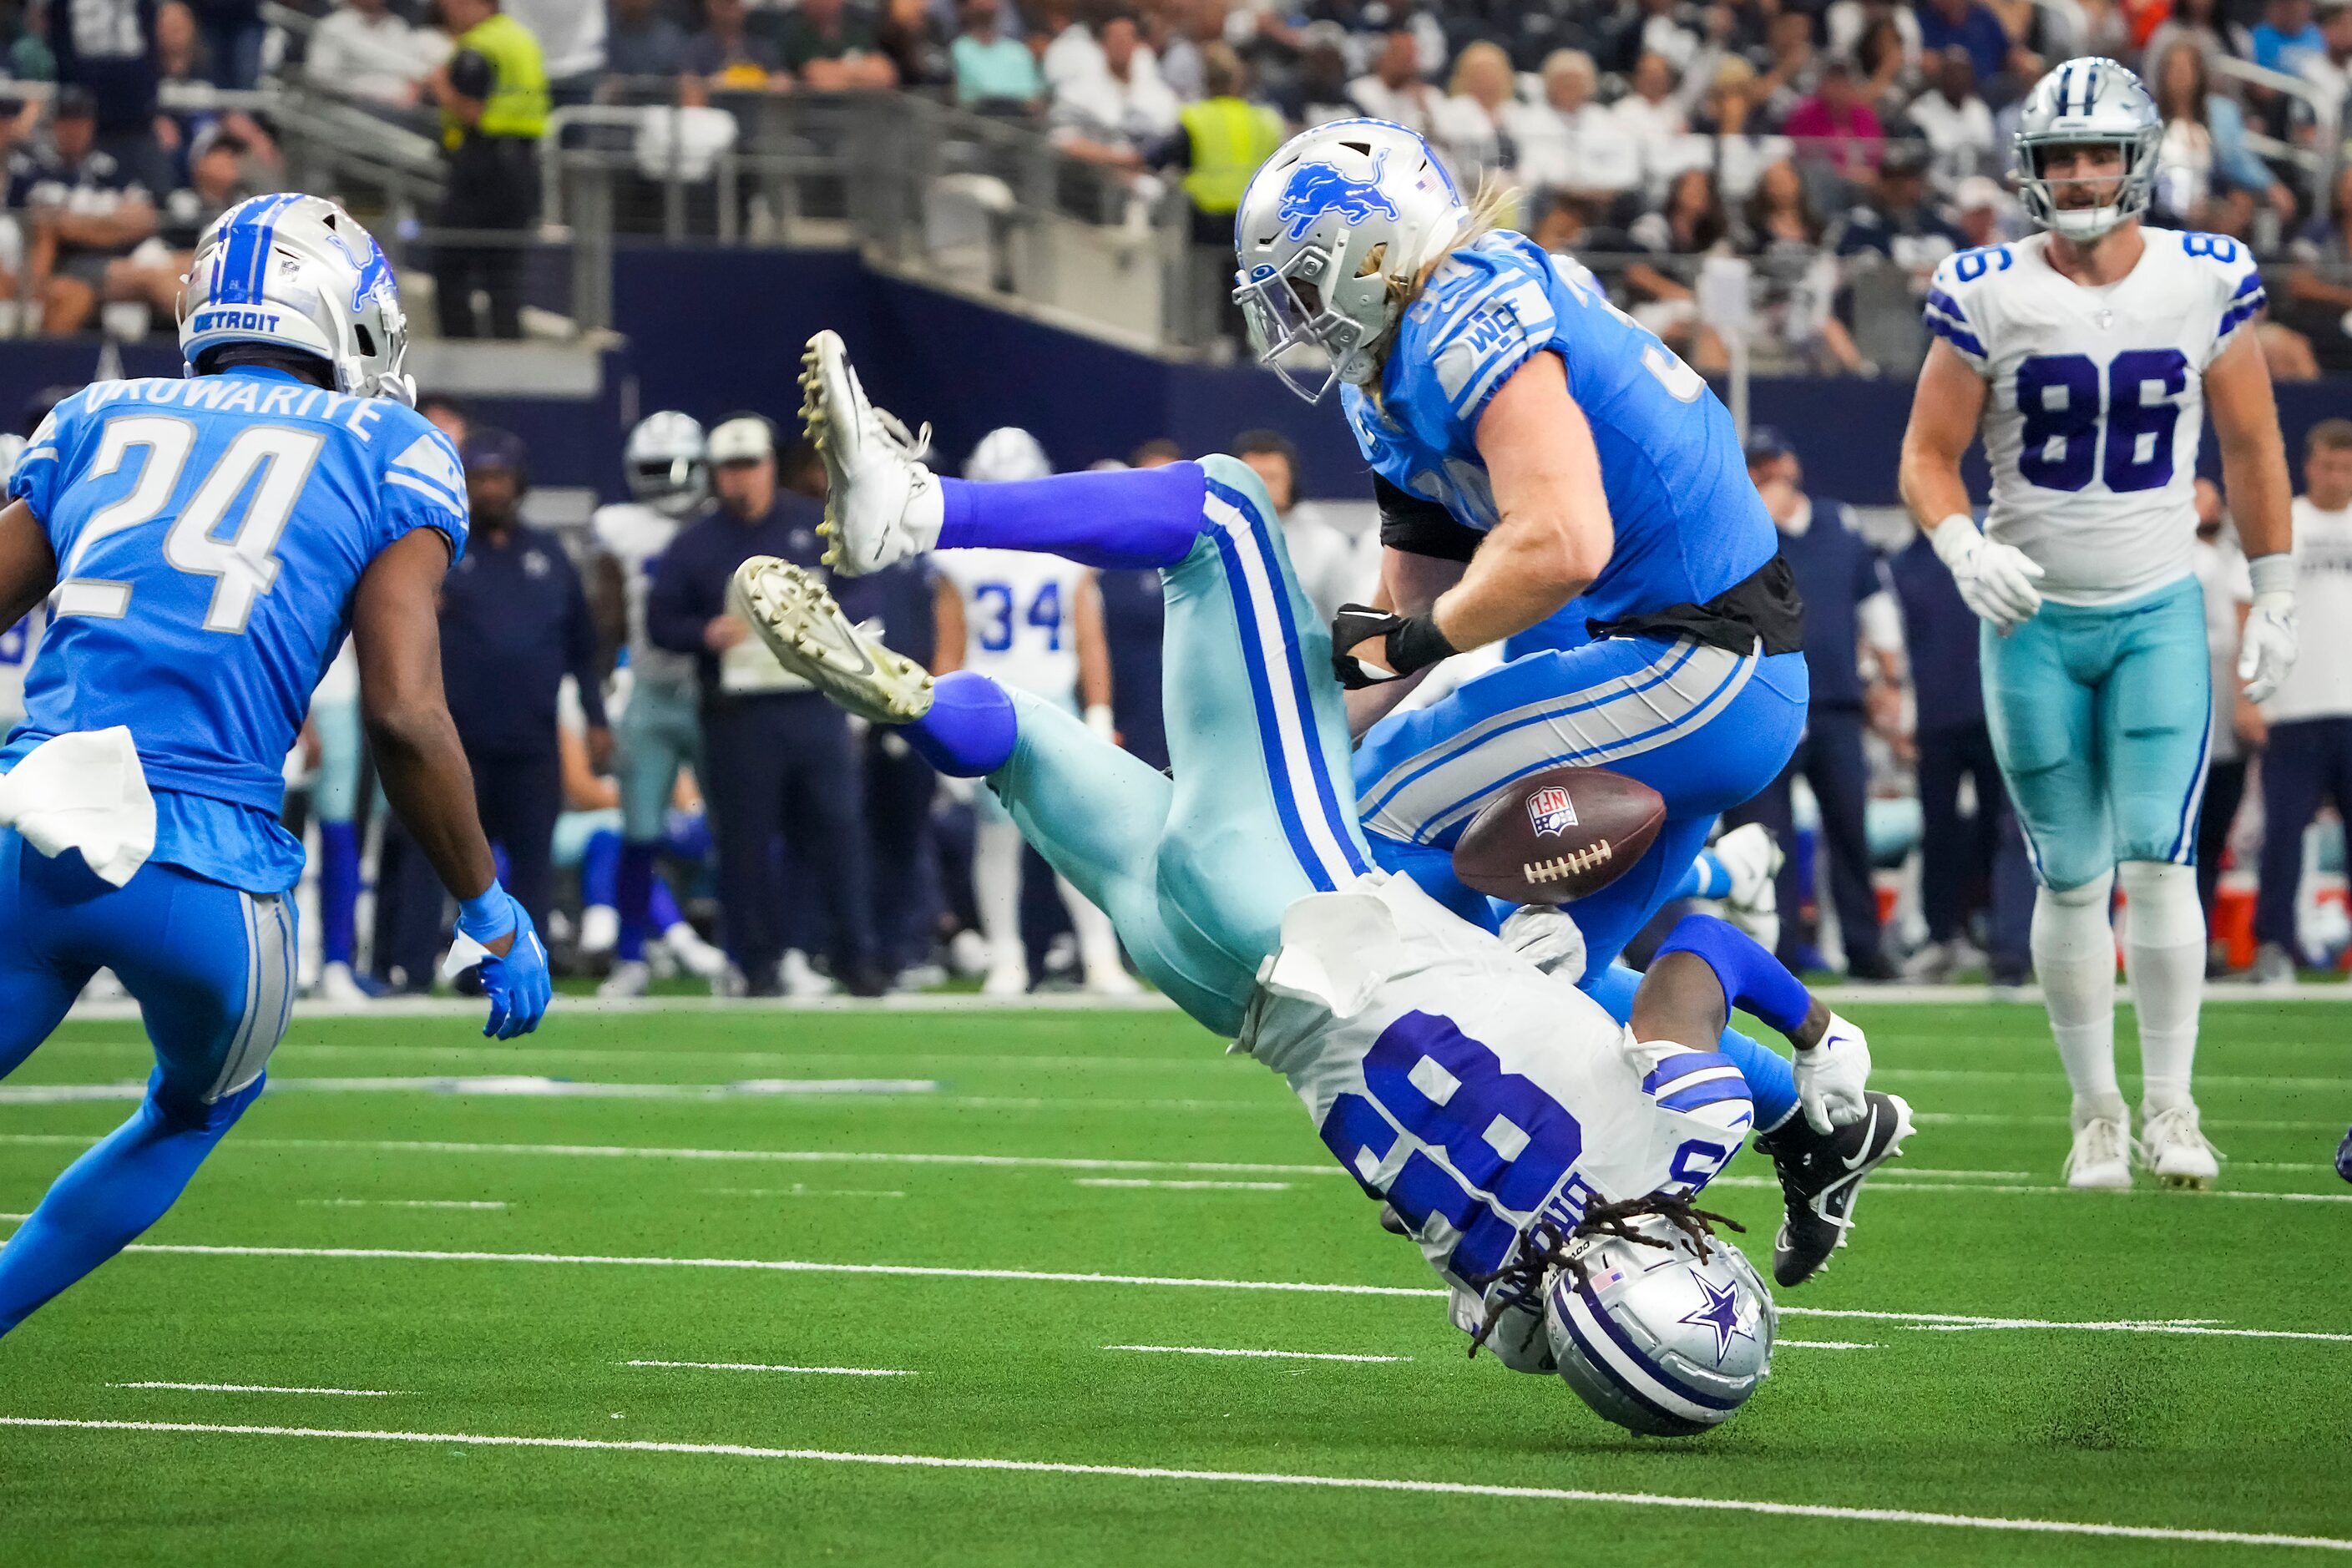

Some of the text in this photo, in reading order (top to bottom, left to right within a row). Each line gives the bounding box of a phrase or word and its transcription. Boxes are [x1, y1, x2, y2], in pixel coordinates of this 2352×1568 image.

[193, 311, 280, 333] DETROIT
[1464, 297, 1520, 354] WCF
[2016, 347, 2188, 493] 86
[52, 414, 326, 635] 24
[974, 580, 1062, 652] 34
[1531, 791, 1566, 816] NFL
[1319, 1009, 1582, 1300] 85
